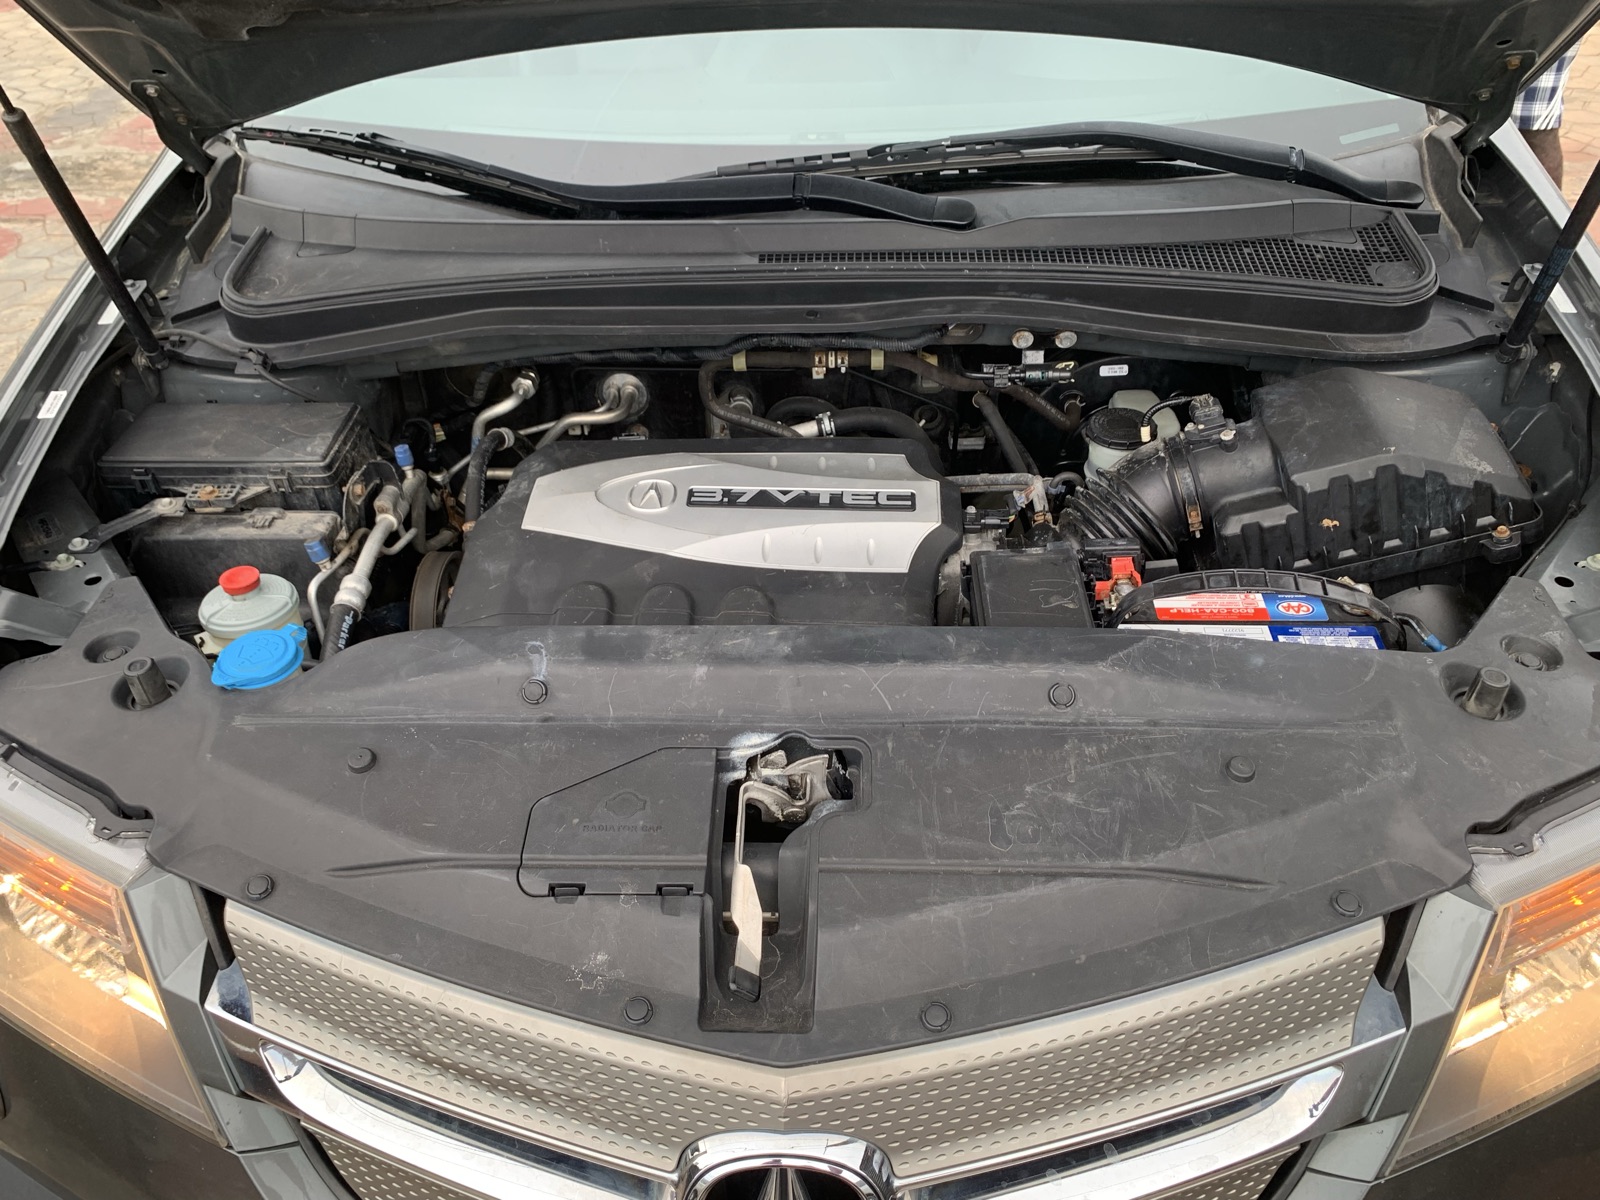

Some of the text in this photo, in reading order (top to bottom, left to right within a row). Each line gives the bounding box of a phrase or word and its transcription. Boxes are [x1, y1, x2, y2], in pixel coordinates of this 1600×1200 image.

[1281, 603, 1311, 615] CAA
[582, 824, 663, 833] RADIATOR CAP
